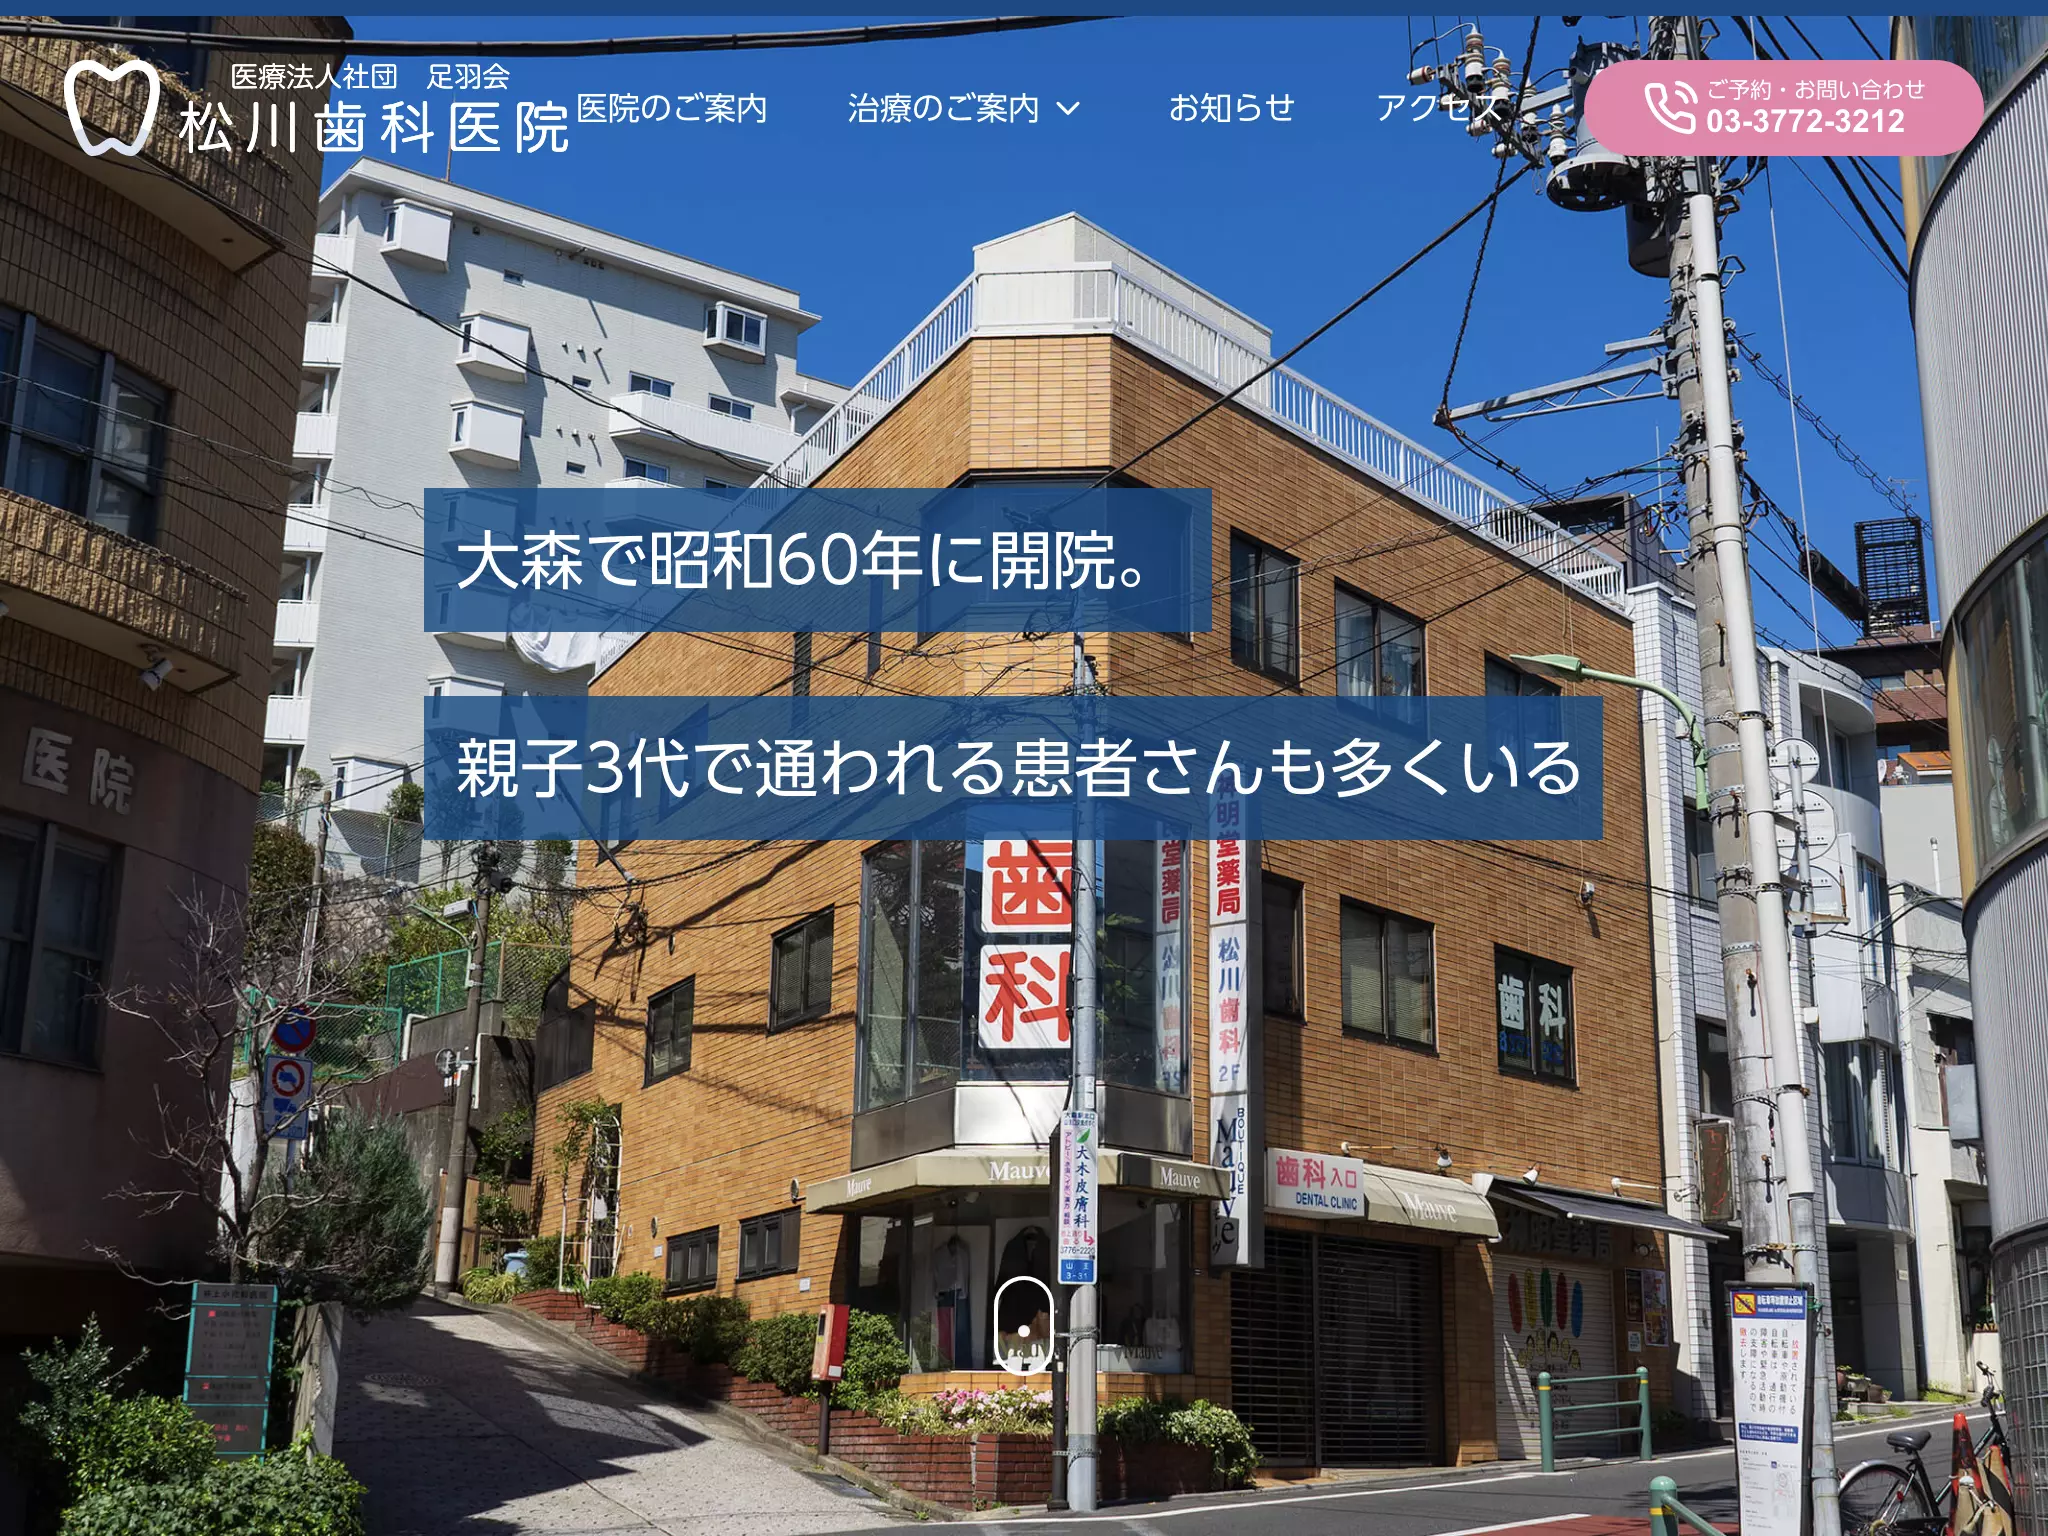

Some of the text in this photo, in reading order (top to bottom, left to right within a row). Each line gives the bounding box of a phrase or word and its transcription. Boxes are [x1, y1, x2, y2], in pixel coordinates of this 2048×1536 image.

[22, 726, 135, 815] 医院
[985, 837, 1073, 1042] 歯科
[1217, 936, 1240, 1083] 松川歯科 2F
[1498, 973, 1566, 1040] 歯科
[846, 1177, 872, 1199] Mauve
[1073, 1145, 1091, 1228] 大木皮膚科
[1159, 1165, 1202, 1190] Mauve
[1237, 1107, 1245, 1195] BOUTIQUE
[1296, 1192, 1358, 1210] DENTAL CLINIC
[1403, 1191, 1459, 1224] Mauve
